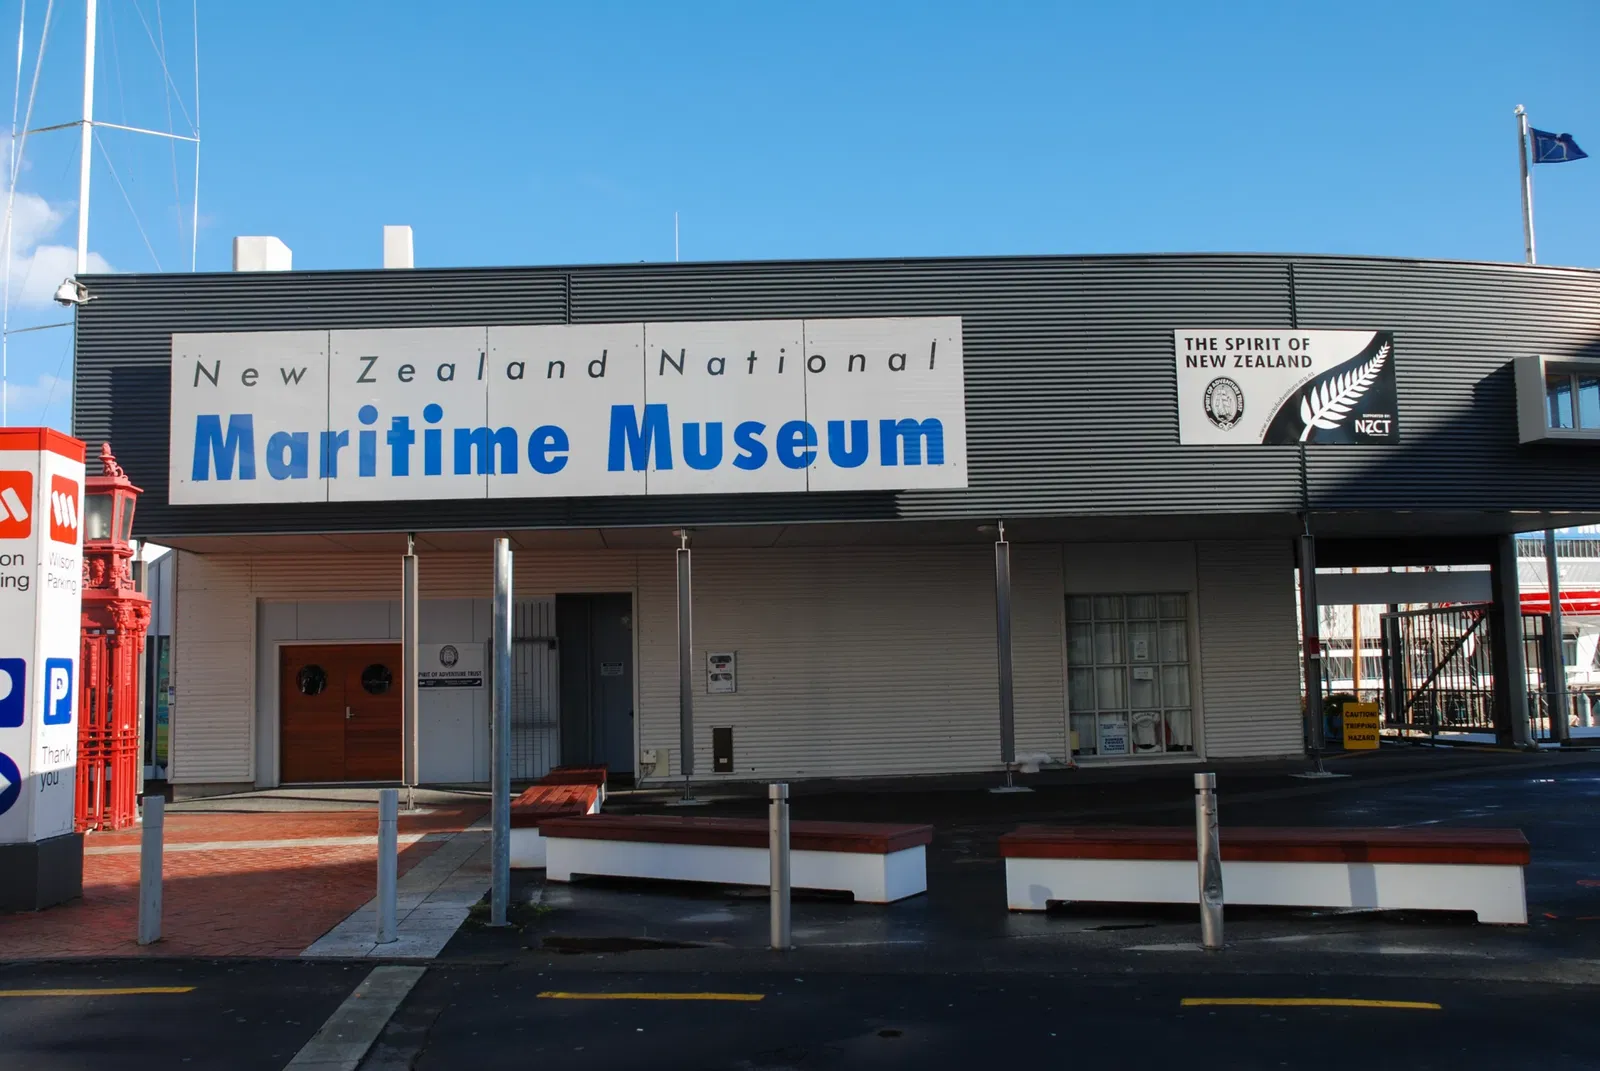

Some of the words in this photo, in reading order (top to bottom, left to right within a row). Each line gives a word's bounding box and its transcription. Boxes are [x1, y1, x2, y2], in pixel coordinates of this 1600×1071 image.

[1184, 337, 1218, 351] THE
[1225, 337, 1281, 351] SPIRIT
[1288, 337, 1311, 351] OF
[193, 359, 307, 388] New
[356, 349, 608, 384] Zealand
[659, 341, 937, 376] National
[1185, 355, 1227, 368] NEW
[1233, 354, 1313, 368] ZEALAND
[1354, 419, 1392, 434] NZCT
[191, 403, 570, 481] Maritime
[607, 403, 944, 472] Museum
[48, 552, 75, 570] Wilson
[47, 572, 77, 595] Parking
[42, 746, 71, 764] Thank
[40, 771, 59, 792] you
